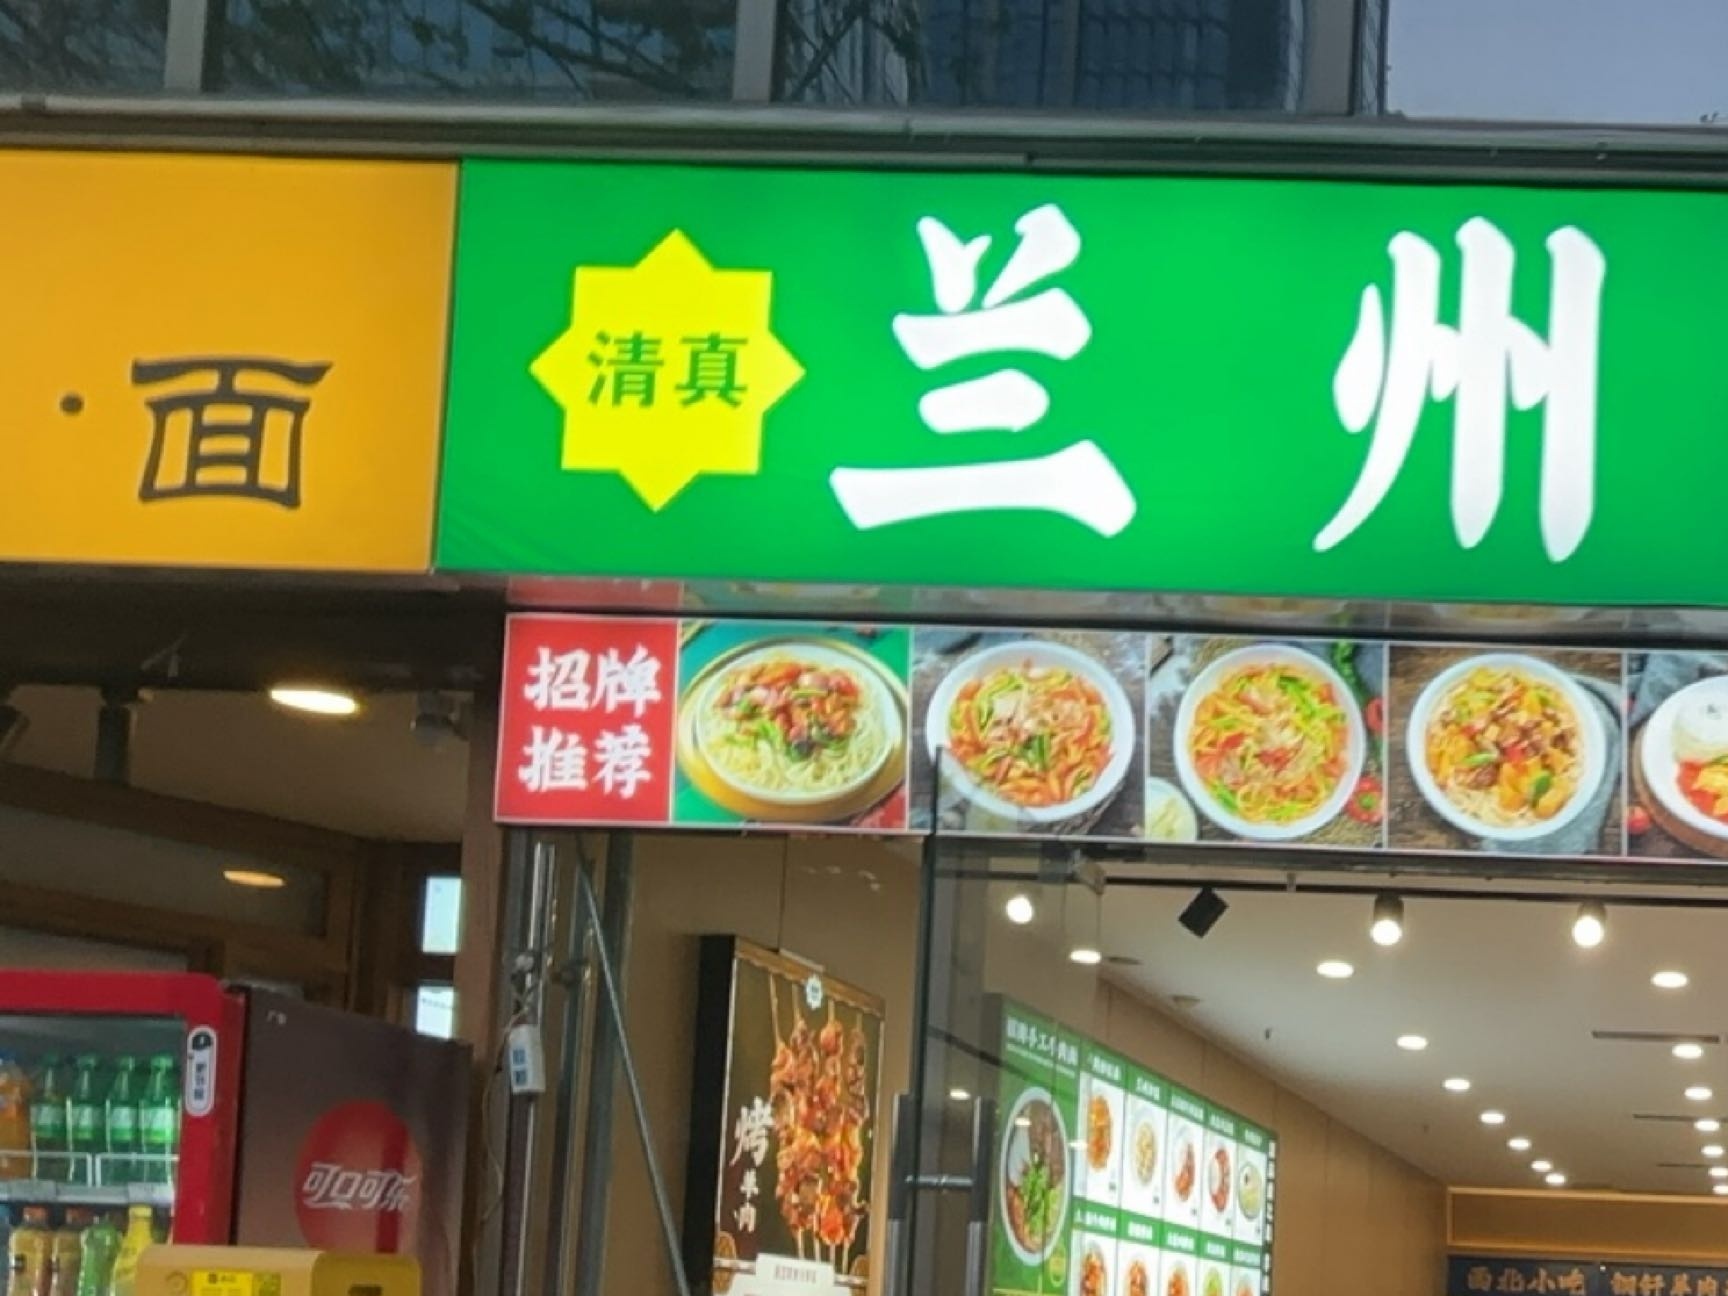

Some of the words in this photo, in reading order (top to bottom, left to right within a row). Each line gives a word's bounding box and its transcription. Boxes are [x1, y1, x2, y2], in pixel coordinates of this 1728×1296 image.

[587, 331, 748, 409] 清真
[523, 647, 662, 714] 招牌
[517, 726, 654, 799] 推荐
